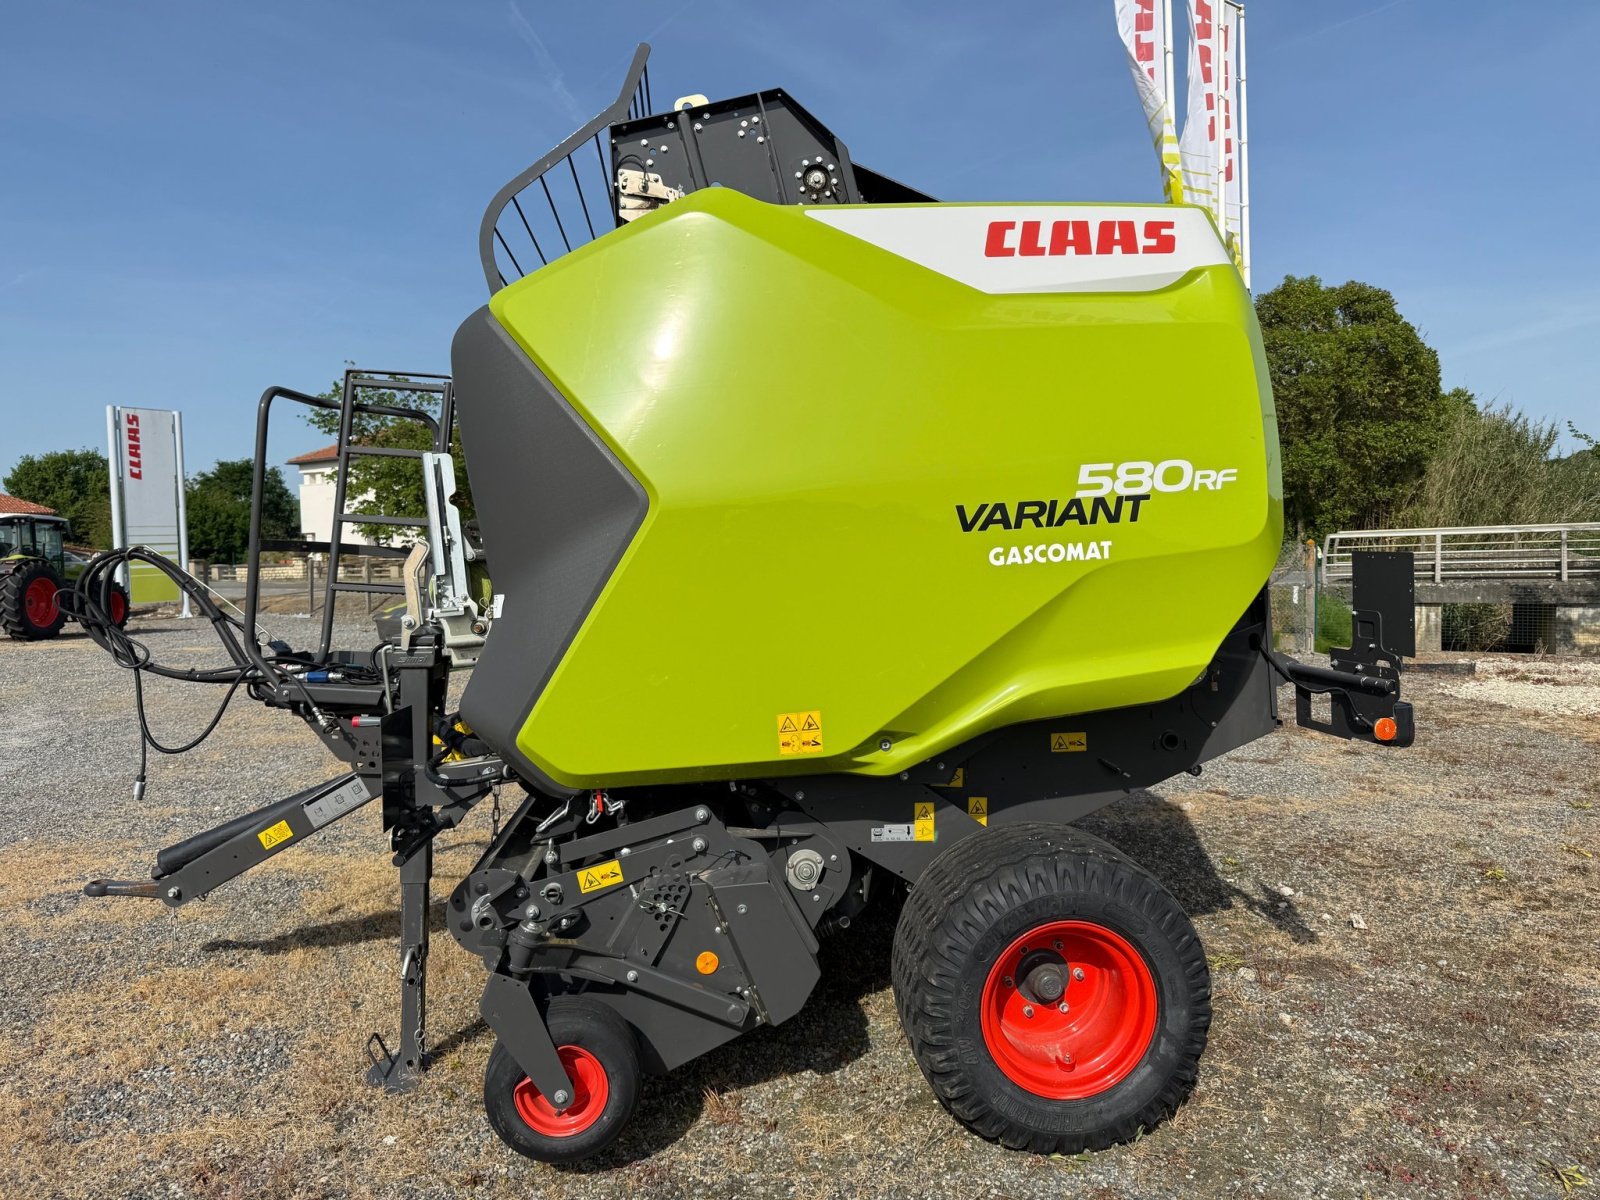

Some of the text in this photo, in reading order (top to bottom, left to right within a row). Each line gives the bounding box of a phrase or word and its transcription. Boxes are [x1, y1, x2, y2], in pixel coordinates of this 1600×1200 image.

[985, 220, 1176, 257] CLAAS
[126, 413, 143, 480] CLAAS
[955, 494, 1151, 533] VARIANT
[988, 541, 1112, 566] GASCOMAT
